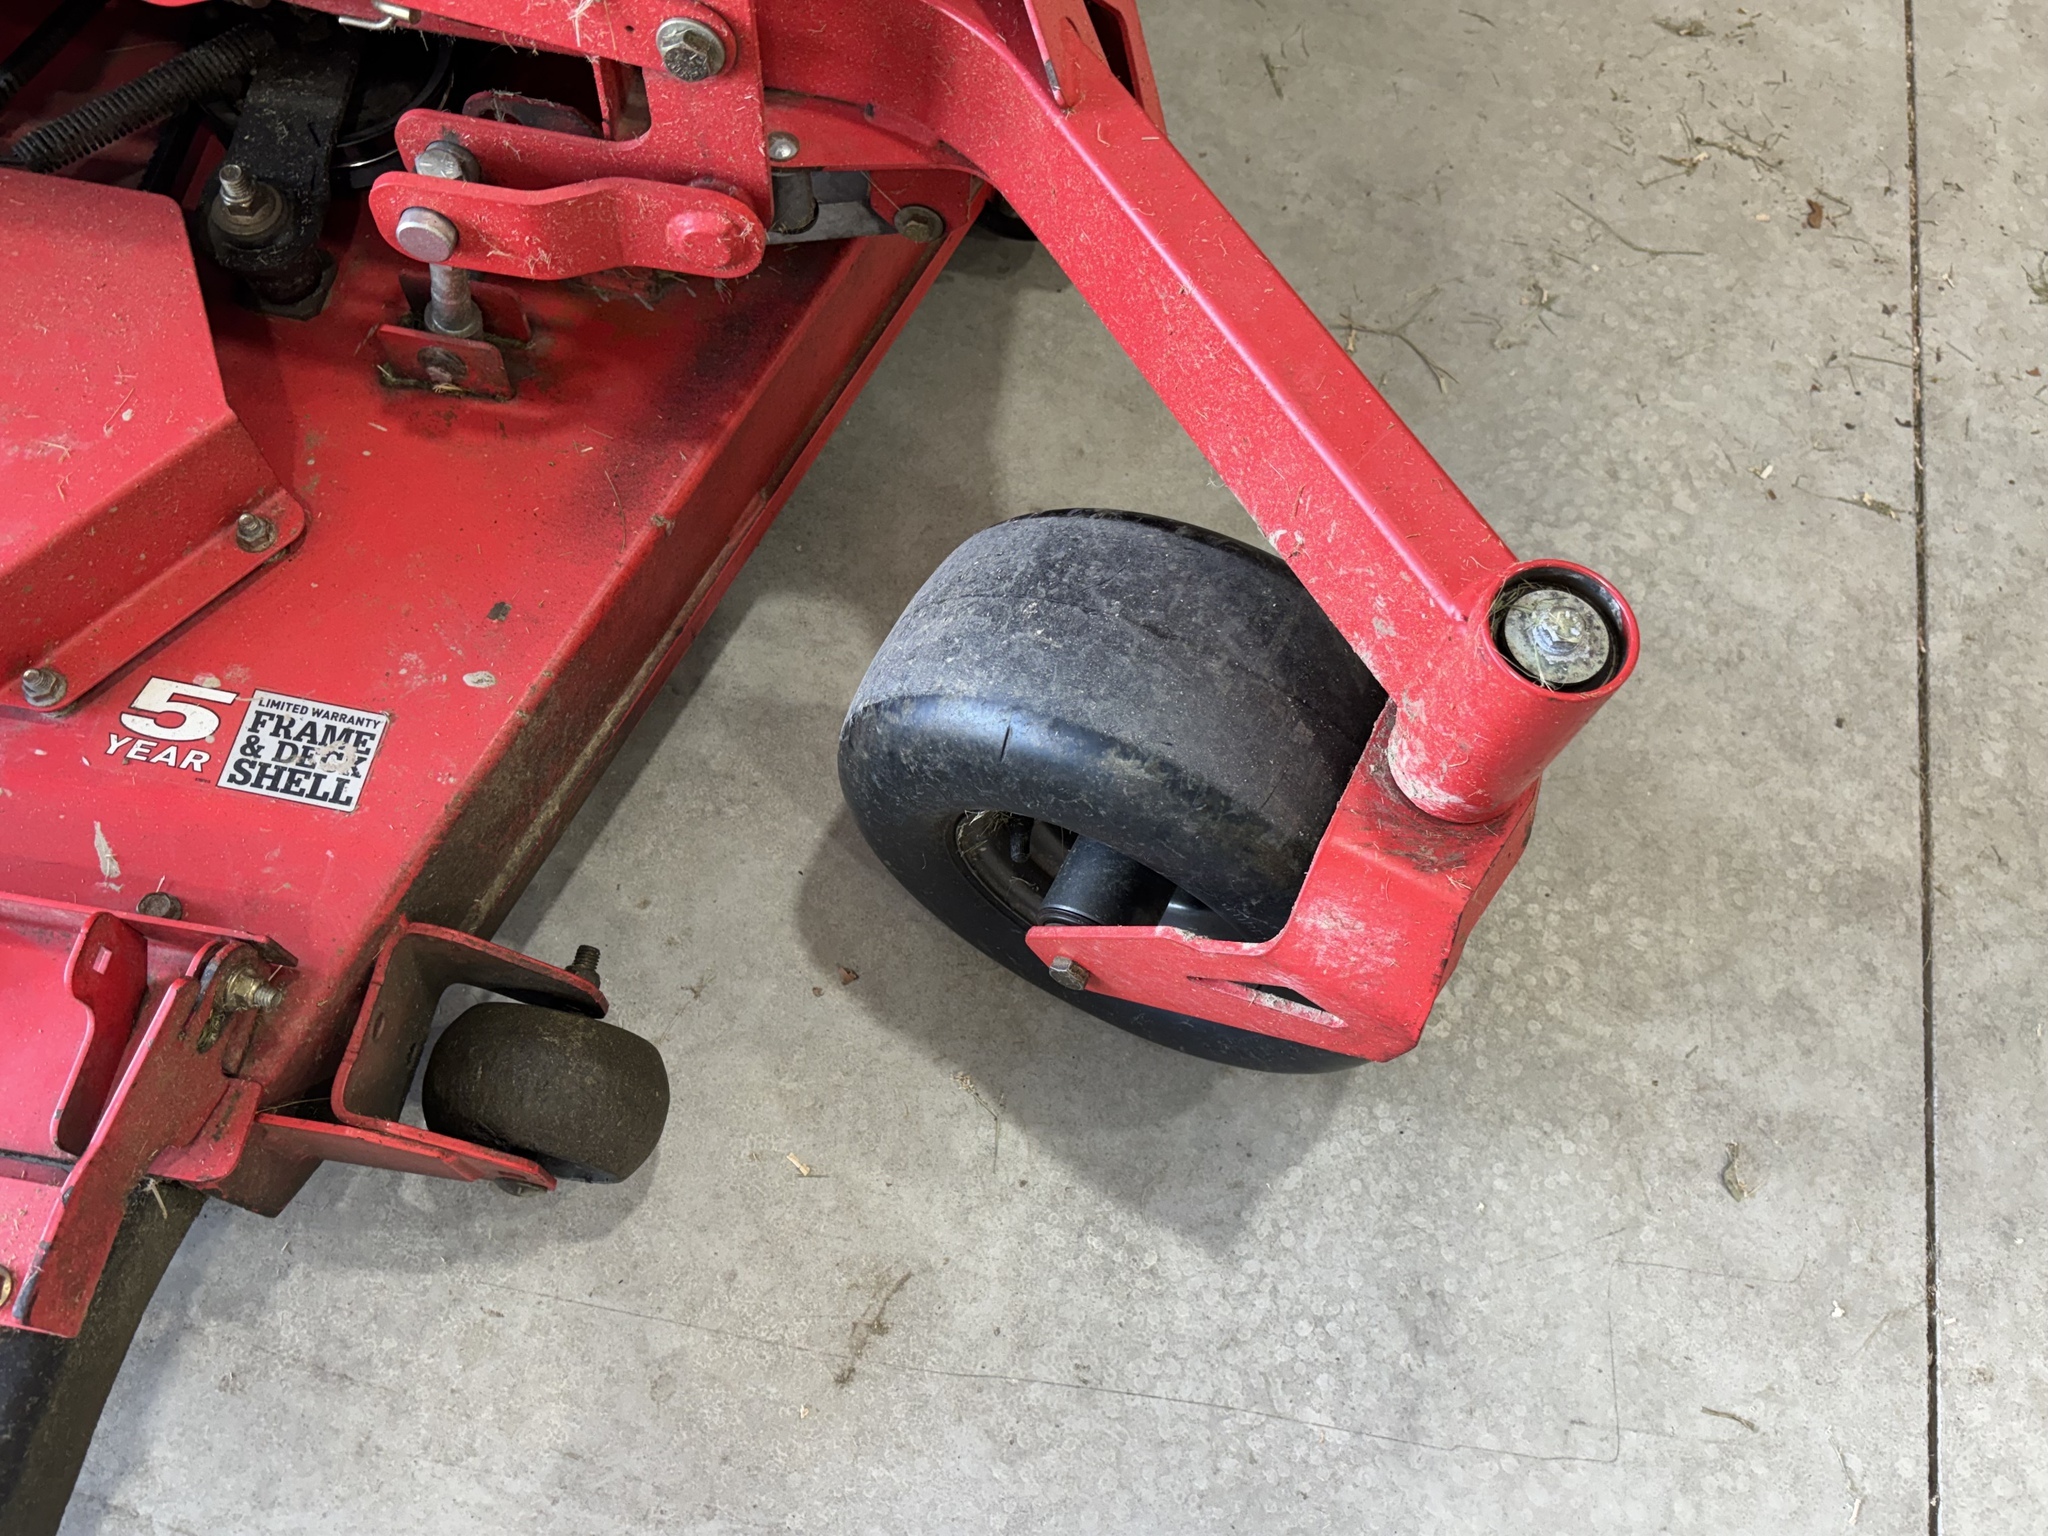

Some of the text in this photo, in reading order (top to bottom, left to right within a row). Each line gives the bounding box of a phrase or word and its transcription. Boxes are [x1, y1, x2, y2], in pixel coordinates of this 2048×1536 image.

[119, 676, 240, 742] 5
[258, 697, 381, 729] LIMITED WARRANTY
[105, 733, 211, 773] YEAR
[240, 735, 263, 759] &
[248, 710, 376, 756] FRAME
[227, 757, 353, 806] SHELL
